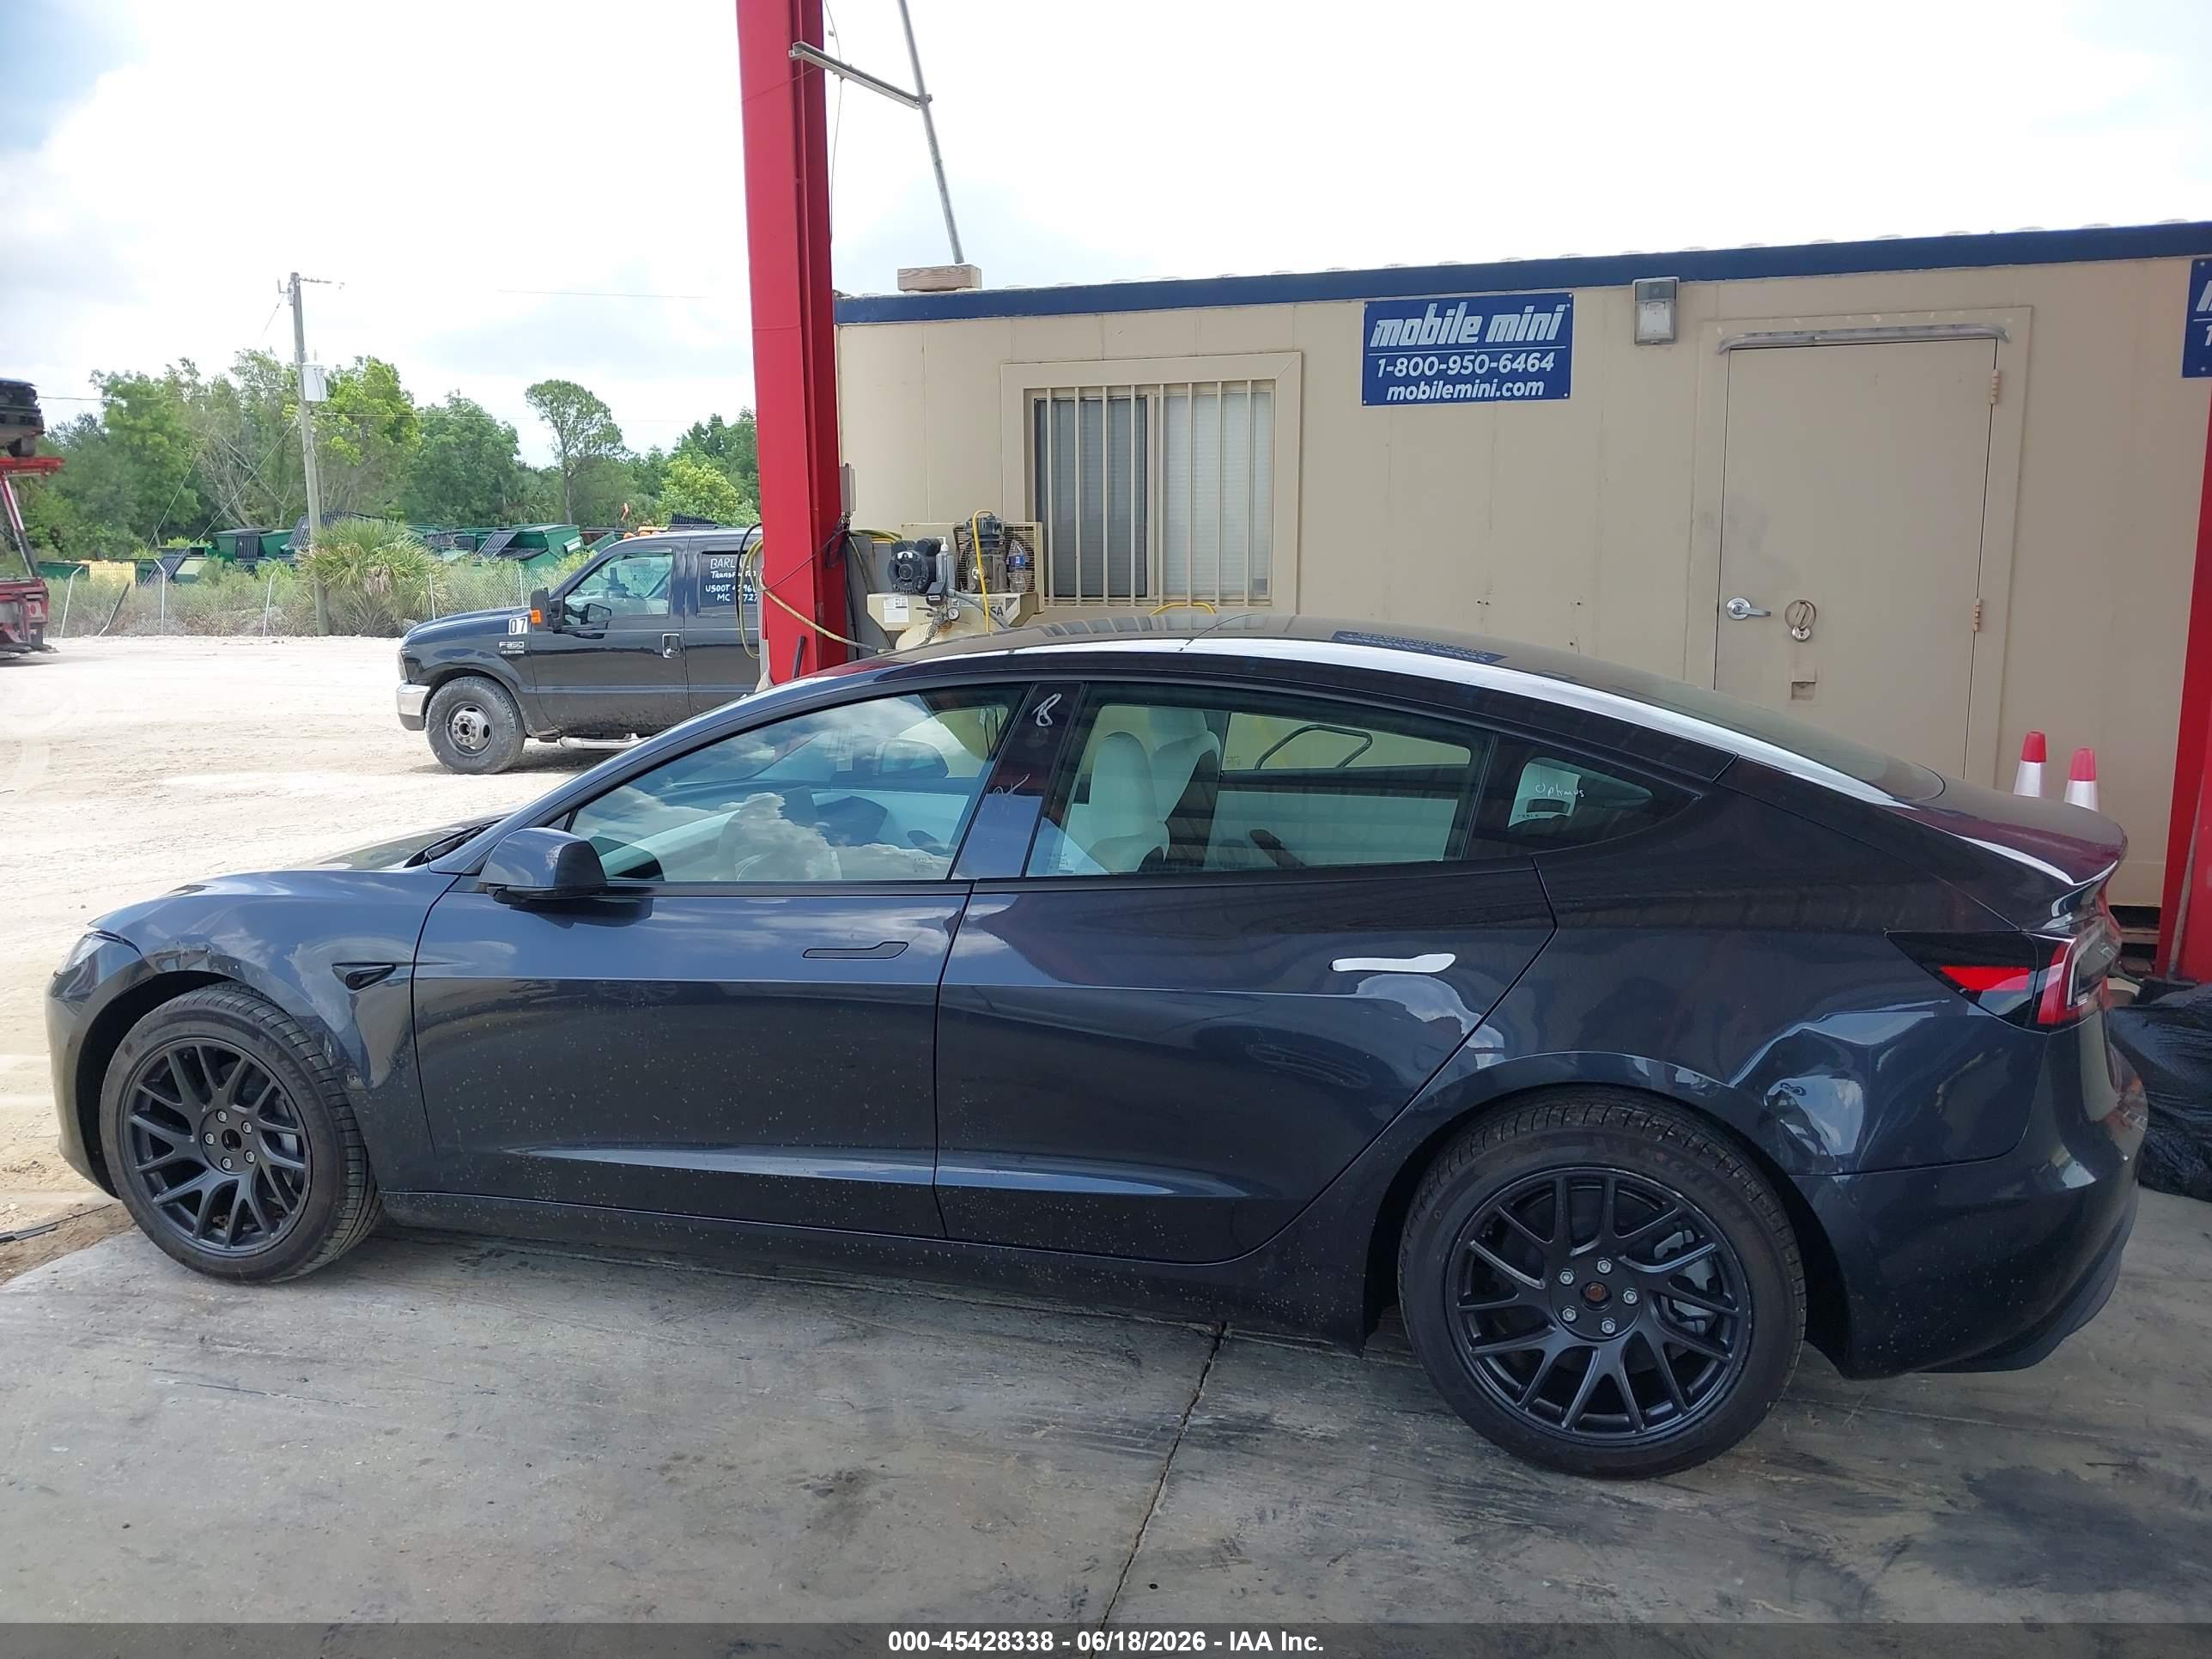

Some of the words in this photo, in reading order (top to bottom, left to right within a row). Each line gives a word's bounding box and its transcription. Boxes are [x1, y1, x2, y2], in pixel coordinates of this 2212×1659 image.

[1370, 302, 1483, 347] mobile
[1485, 304, 1566, 343] mini
[1377, 352, 1555, 378] 1-800-950-6464
[1386, 379, 1545, 401] mobilemini.com
[716, 593, 731, 602] MC
[510, 618, 526, 634] 07
